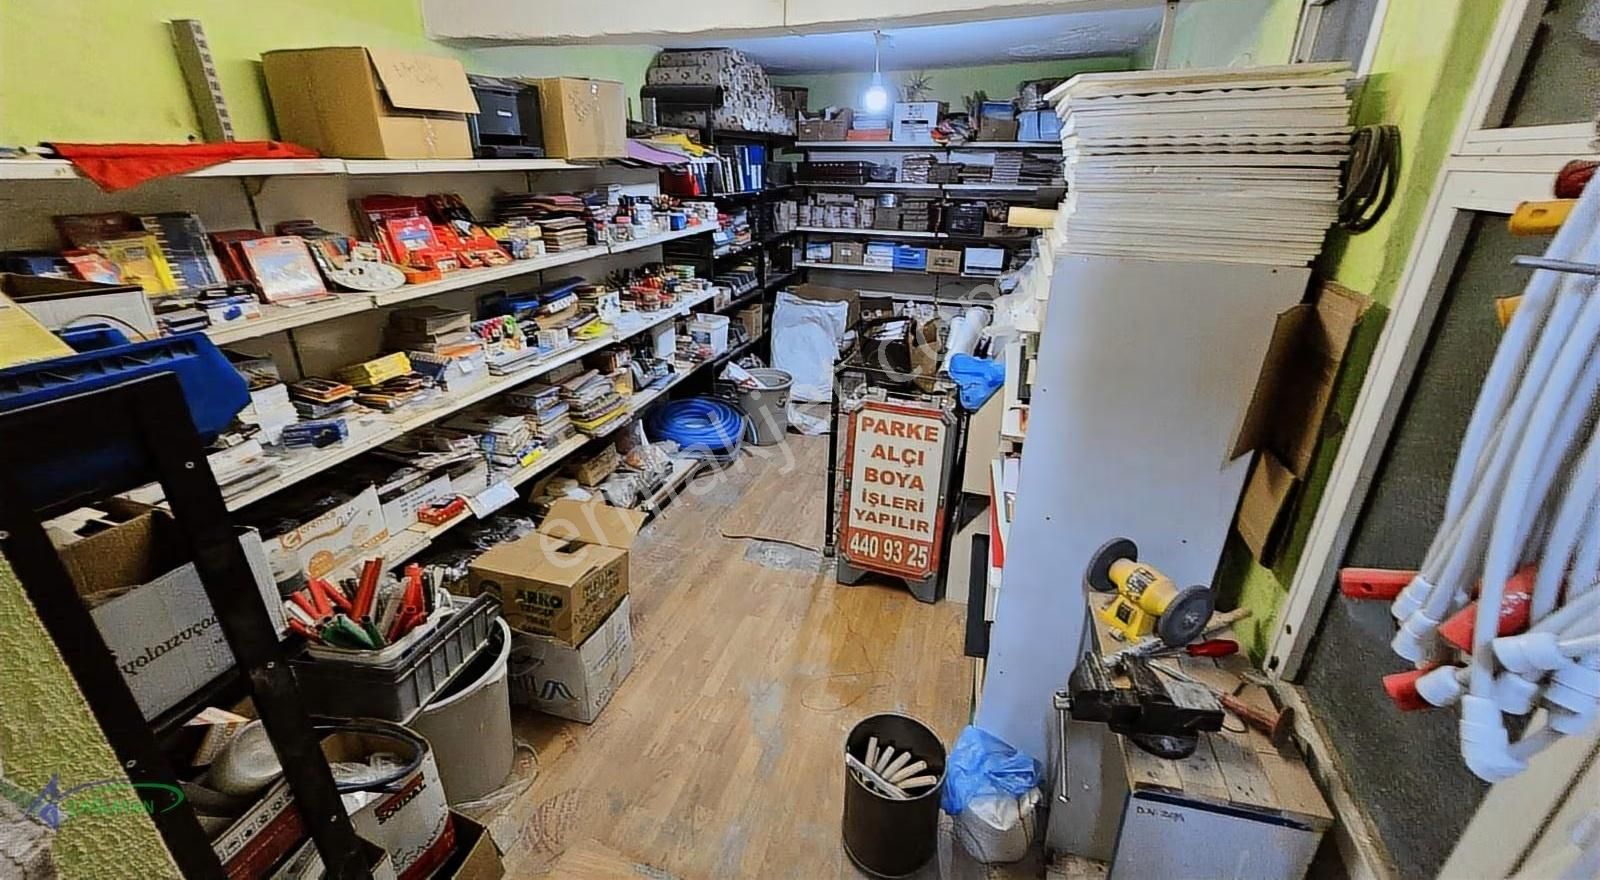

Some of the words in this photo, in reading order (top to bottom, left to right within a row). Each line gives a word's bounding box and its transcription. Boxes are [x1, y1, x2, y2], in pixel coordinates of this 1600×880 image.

[861, 416, 939, 443] PARKE
[871, 444, 925, 468] ALÇI
[864, 467, 925, 491] BOYA
[862, 488, 925, 513] İŞLERİ
[854, 508, 930, 534] YAPILIR
[850, 532, 879, 557] 440
[883, 538, 903, 563] 93
[907, 543, 929, 569] 25
